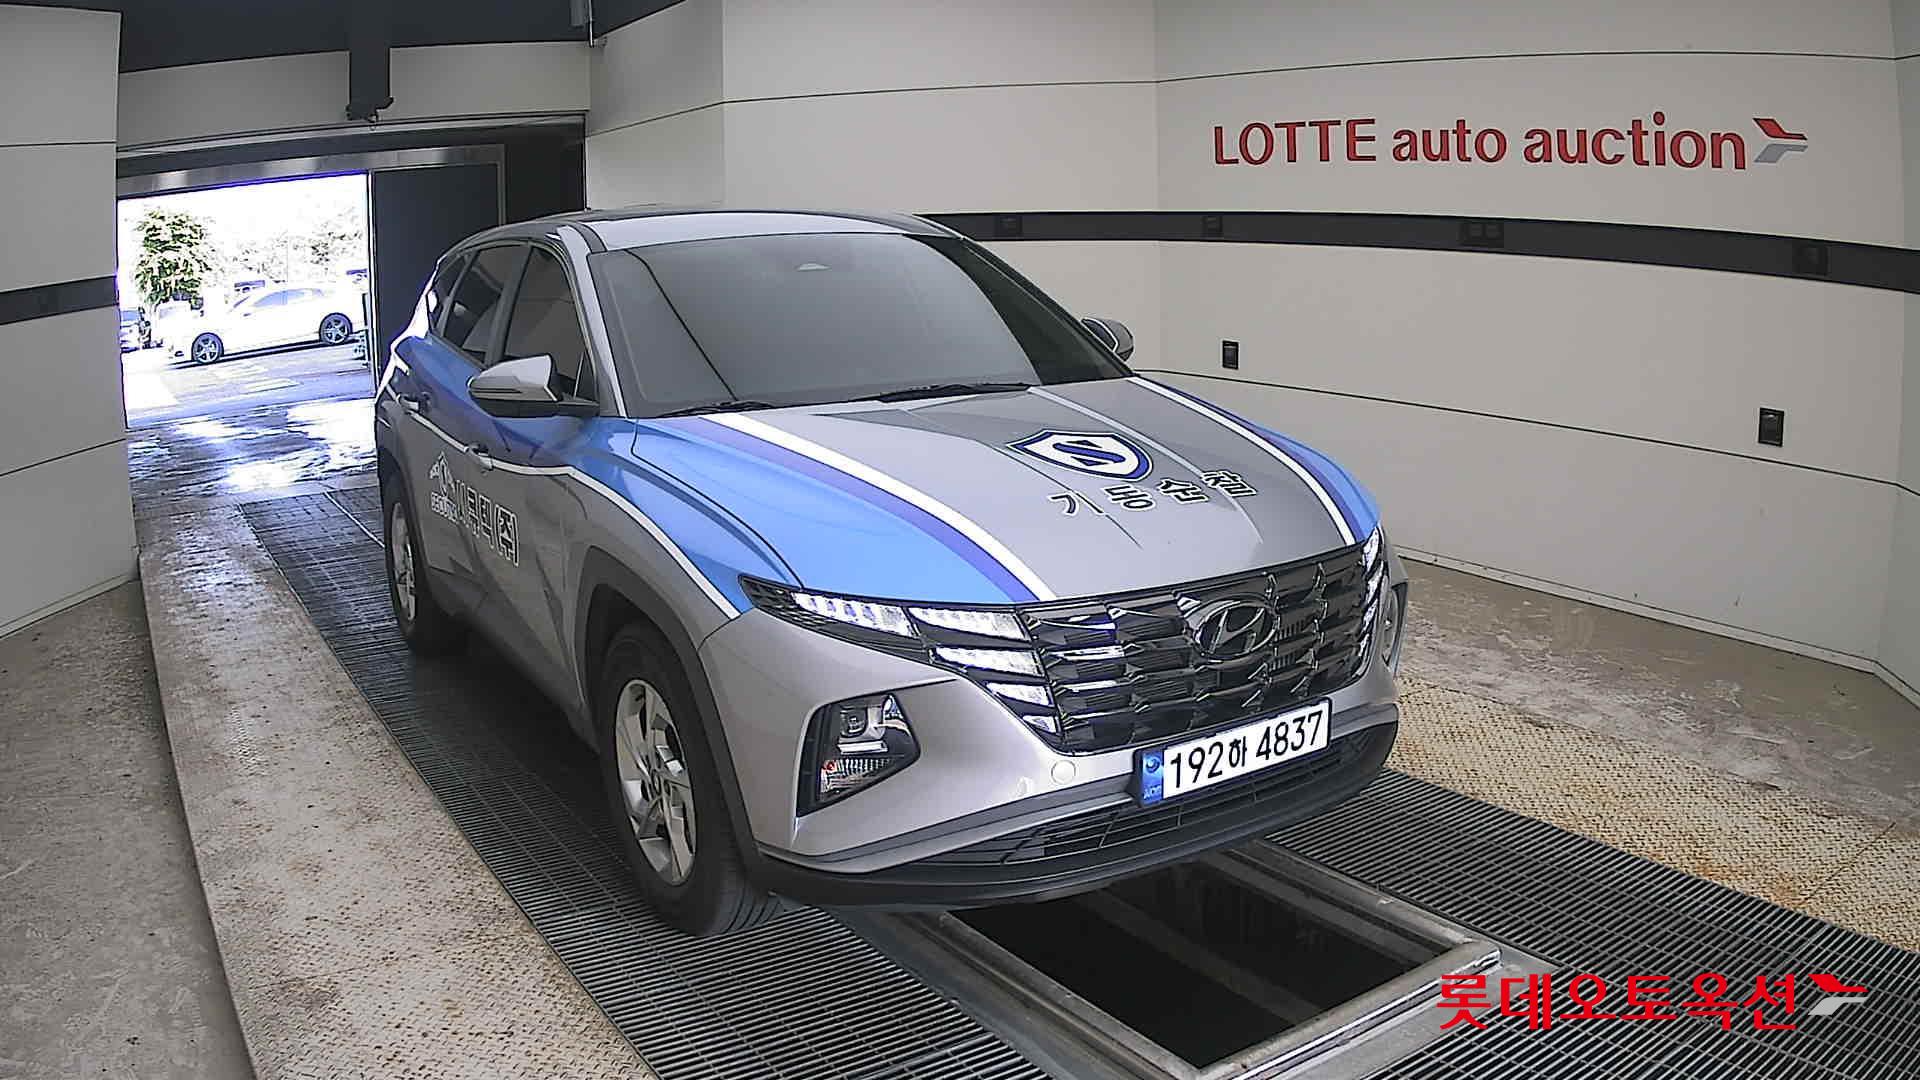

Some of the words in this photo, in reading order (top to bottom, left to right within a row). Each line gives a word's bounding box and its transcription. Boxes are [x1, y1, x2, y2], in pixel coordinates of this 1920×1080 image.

[1213, 118, 1377, 166] LOTTE
[1392, 118, 1507, 164] auto
[1522, 111, 1747, 171] auction
[1170, 735, 1248, 789] 192하
[1255, 709, 1324, 761] 4837
